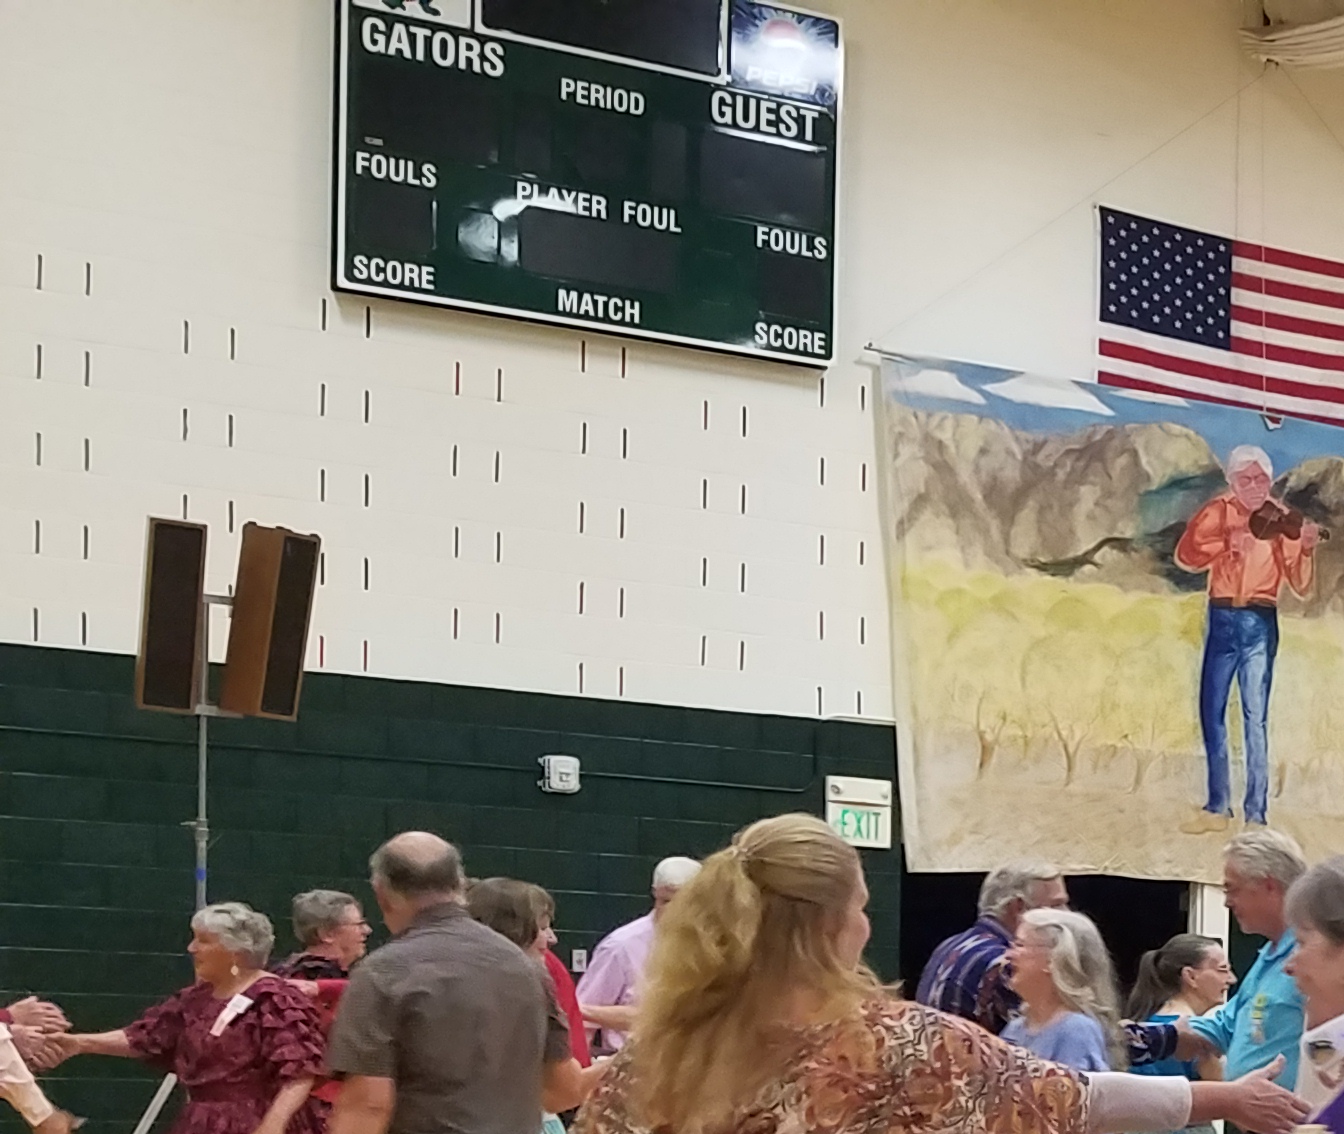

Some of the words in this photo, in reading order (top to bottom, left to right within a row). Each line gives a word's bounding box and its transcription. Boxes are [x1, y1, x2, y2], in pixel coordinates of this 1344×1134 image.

[362, 16, 505, 77] GATORS
[560, 77, 645, 115] PERIOD
[745, 65, 818, 95] PEPSI
[711, 90, 819, 141] GUEST
[355, 151, 437, 188] FOULS
[516, 181, 607, 220] PLAYER
[622, 200, 682, 233] FOUL
[756, 226, 827, 259] FOULS
[353, 254, 435, 290] SCORE
[557, 288, 640, 324] MATCH
[754, 322, 826, 355] SCORE
[841, 809, 882, 840] EXIT
